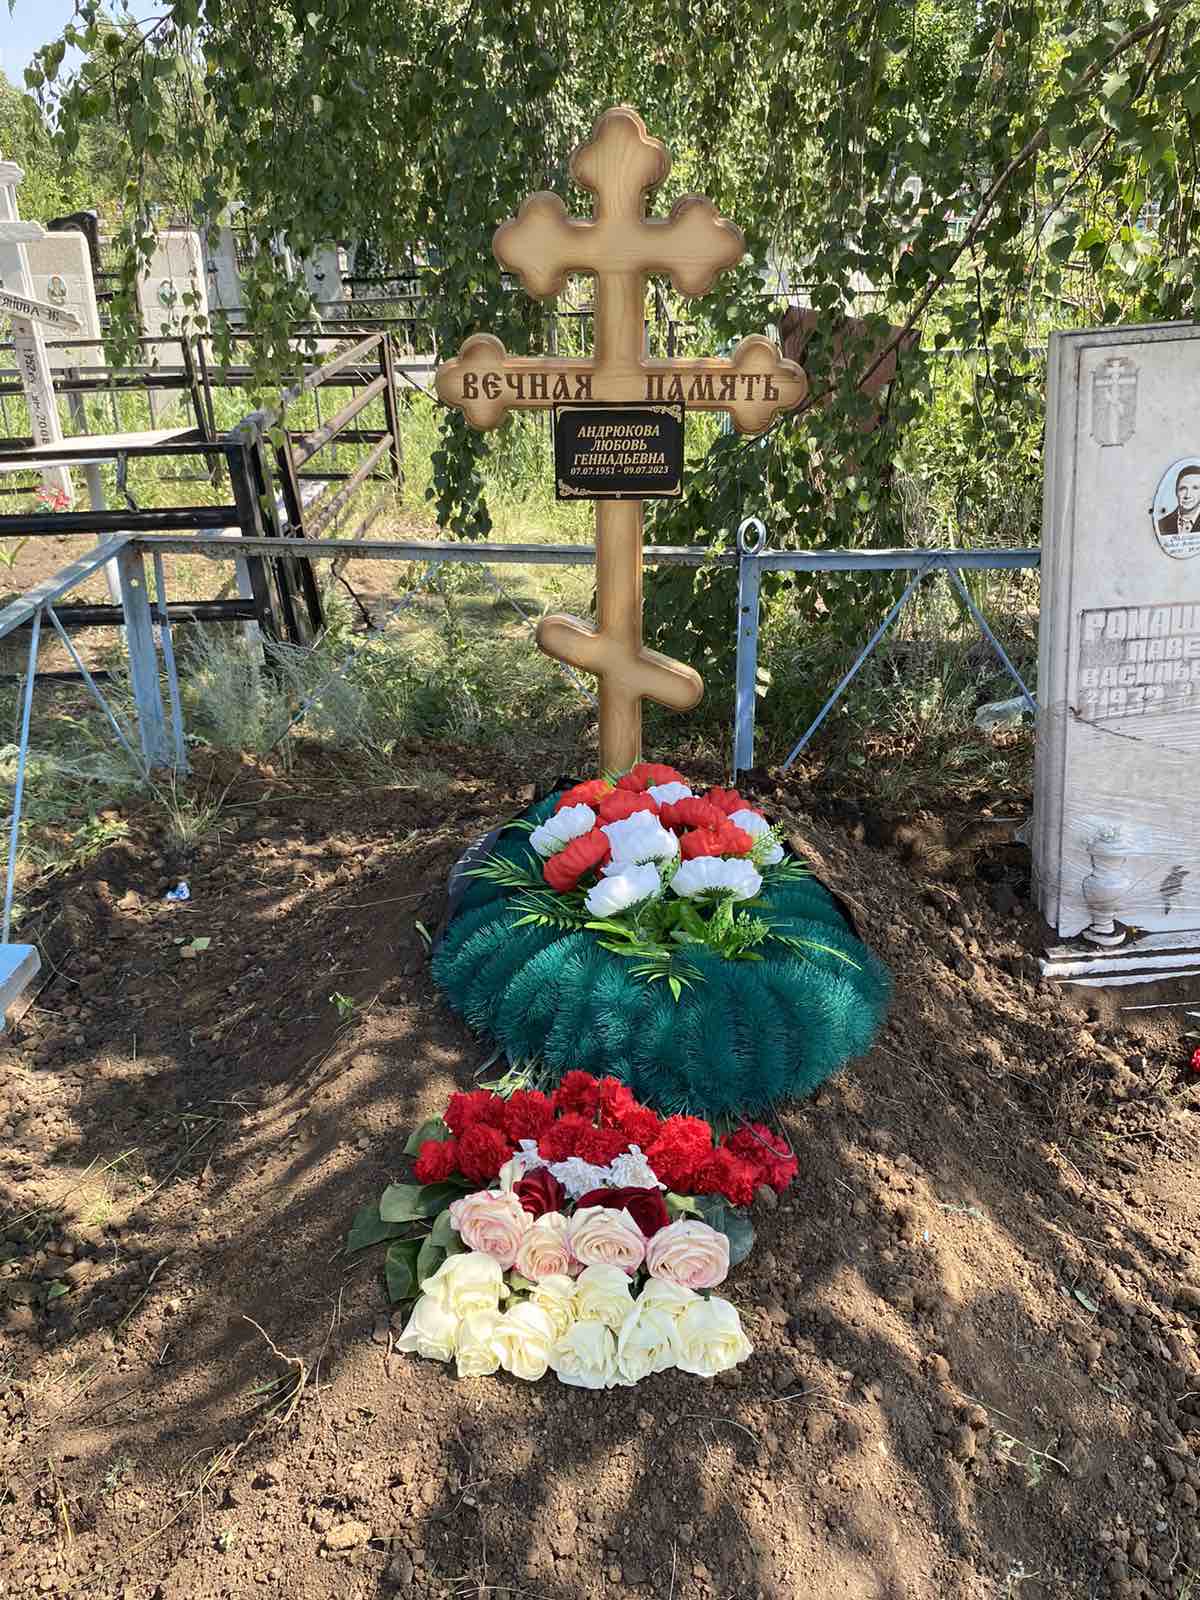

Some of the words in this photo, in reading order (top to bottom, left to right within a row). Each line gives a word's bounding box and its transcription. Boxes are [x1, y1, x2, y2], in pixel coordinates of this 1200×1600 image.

[462, 372, 594, 400] ВЕЧНАЯ
[645, 373, 780, 401] ПАМЯТЬ
[577, 425, 660, 439] АНДРЮКОВА
[591, 440, 647, 451] ЛЮБОВЬ
[574, 453, 665, 466] ГЕННАДЬЕВНА
[623, 465, 669, 474] 09.07.2023
